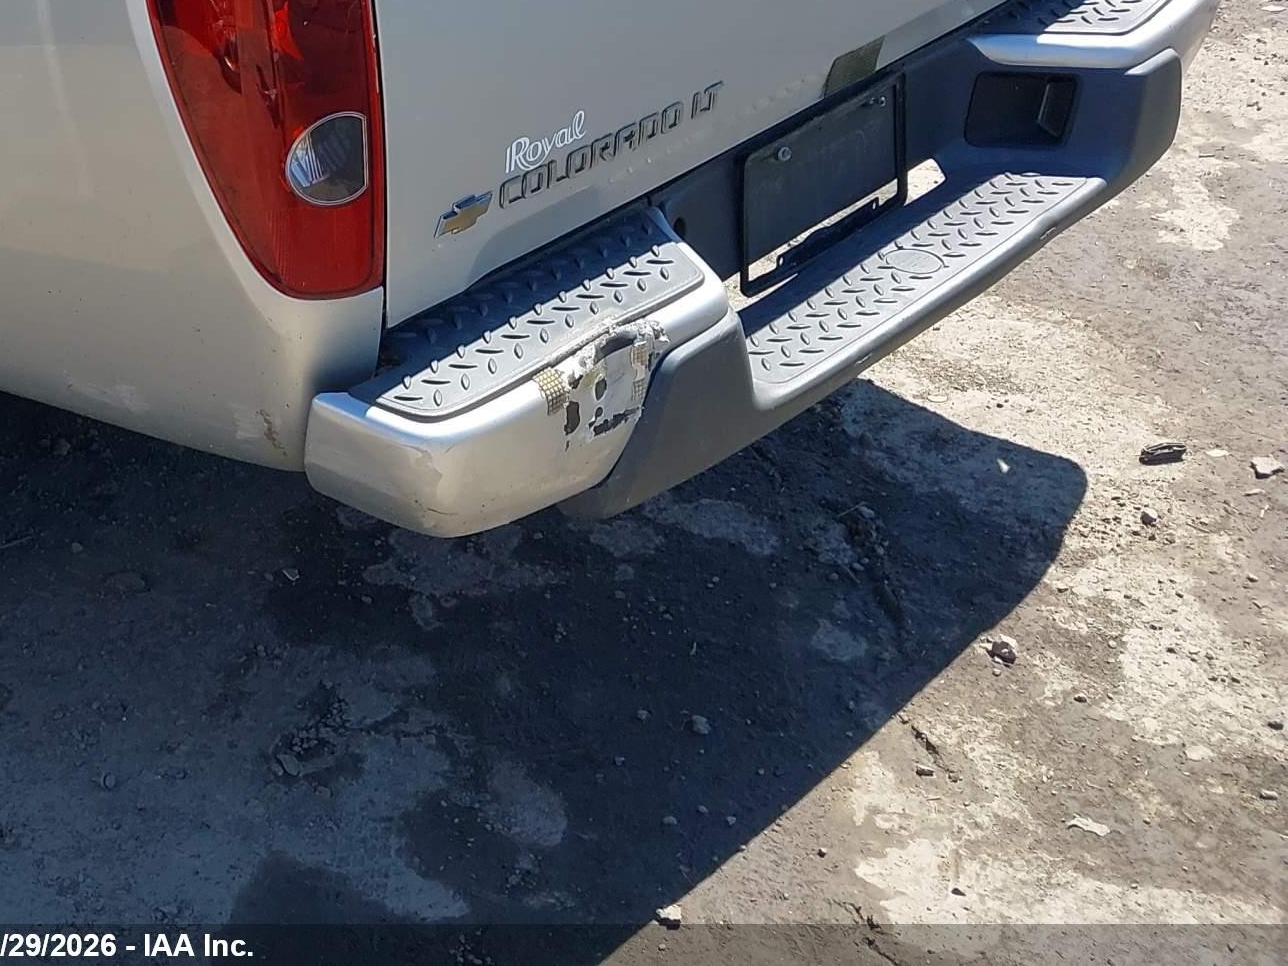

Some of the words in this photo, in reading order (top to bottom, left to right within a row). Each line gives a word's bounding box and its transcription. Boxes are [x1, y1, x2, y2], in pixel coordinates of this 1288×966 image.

[499, 101, 684, 209] COLORADO
[691, 81, 724, 120] LT
[505, 110, 587, 174] Royal
